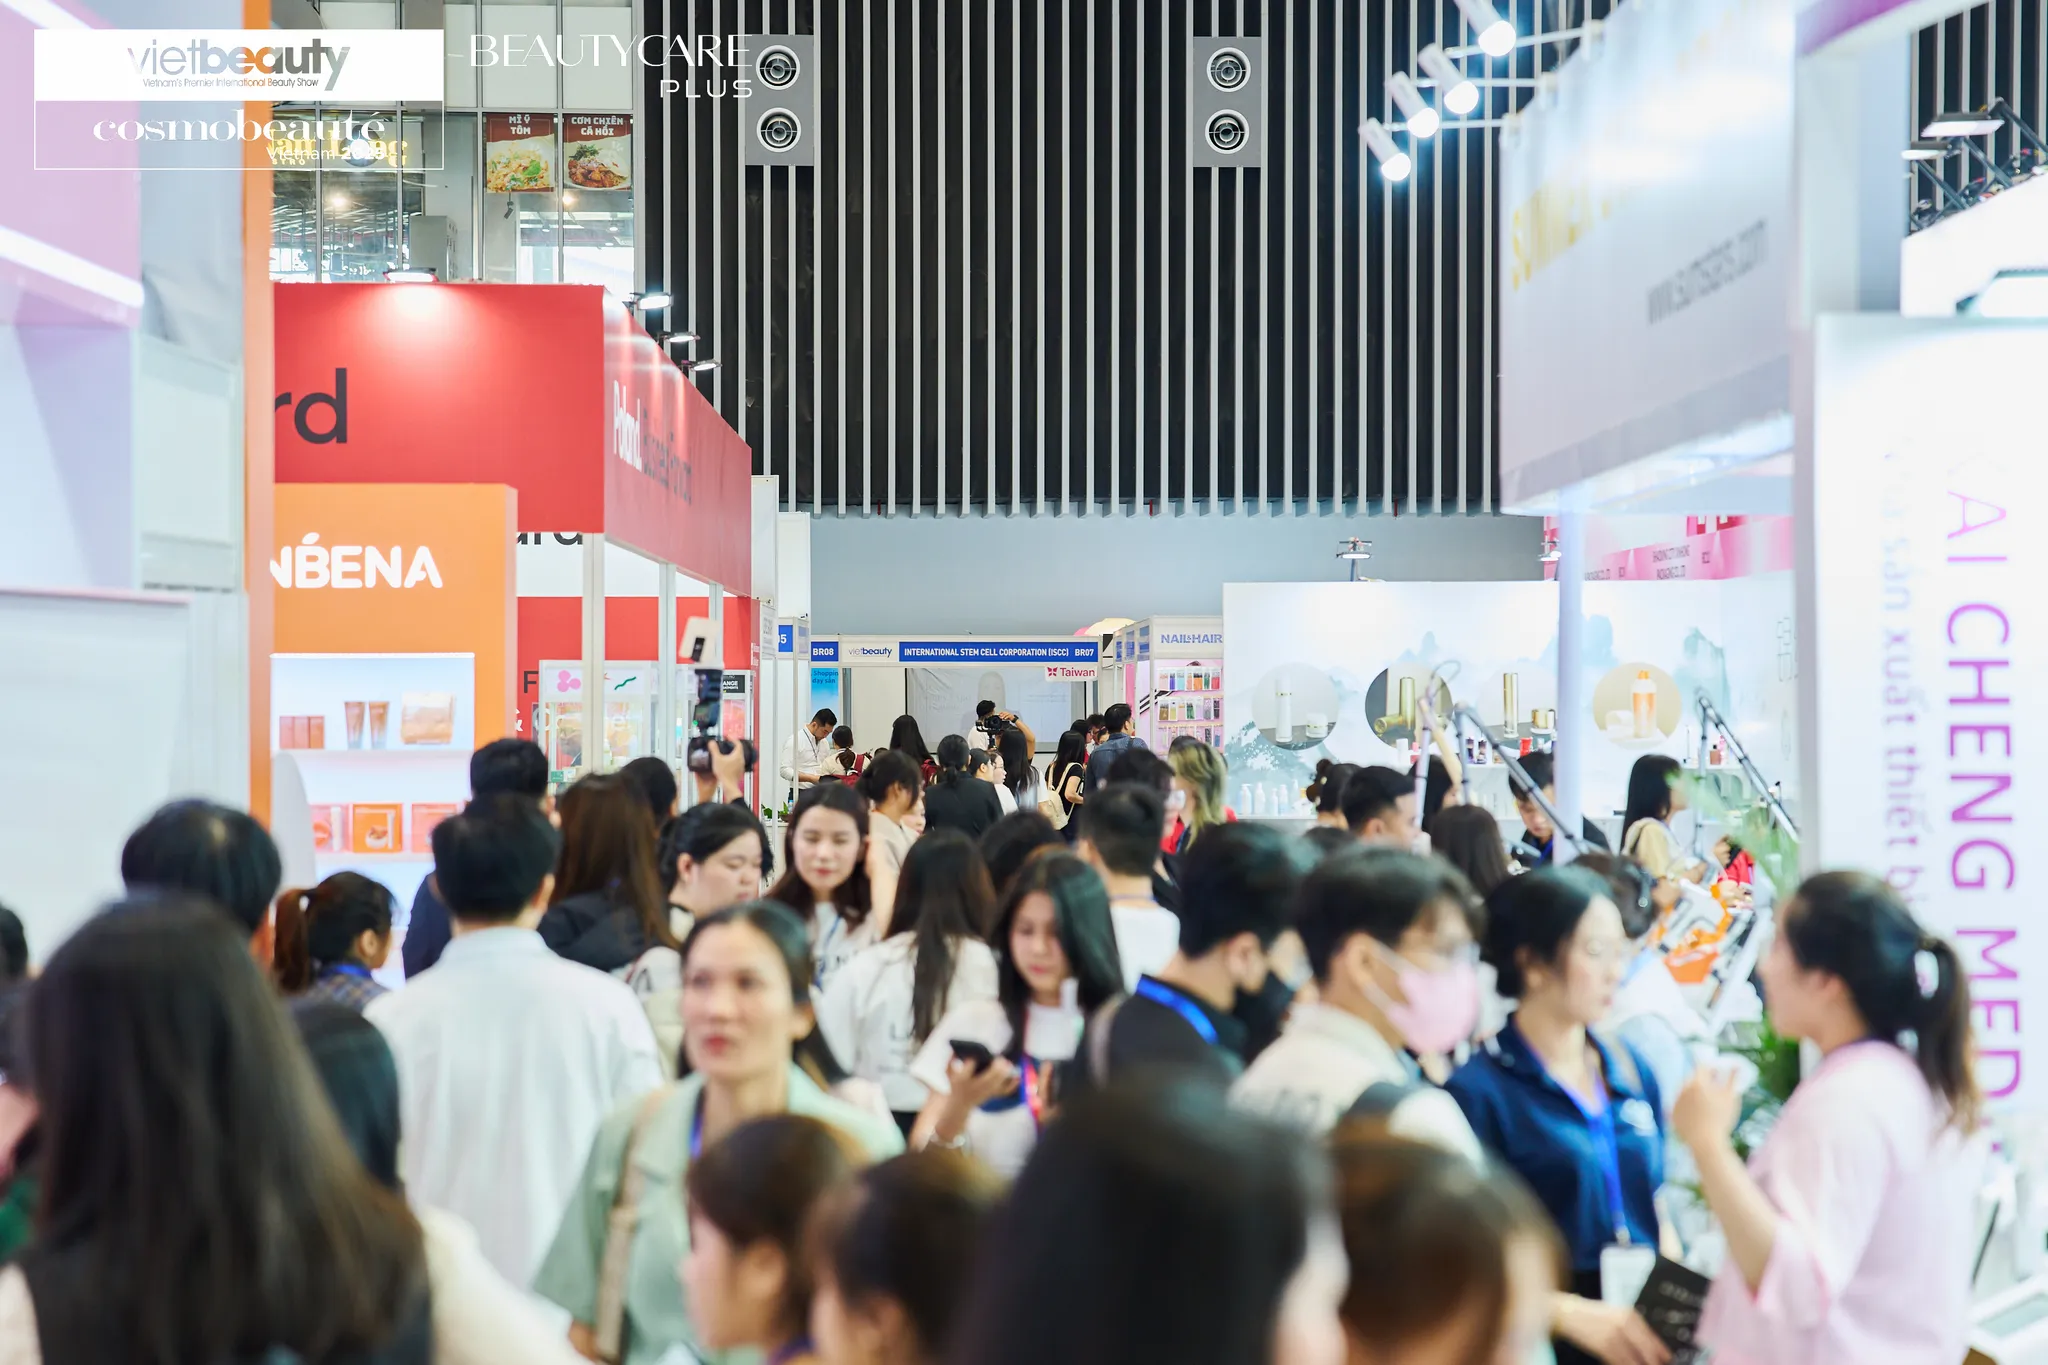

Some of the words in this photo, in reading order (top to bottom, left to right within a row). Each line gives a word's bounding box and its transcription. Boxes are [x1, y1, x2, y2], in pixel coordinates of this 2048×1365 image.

[812, 648, 835, 656] BR08
[848, 647, 892, 658] vietbeauty
[904, 648, 959, 656] INTERNATIONAL
[960, 648, 979, 656] STEM
[980, 648, 998, 656] CELL
[999, 648, 1047, 656] CORPORATION
[1048, 648, 1069, 657] (ISCC)
[1074, 648, 1094, 656] BR07
[1059, 667, 1096, 677] Taiwan
[1946, 602, 2015, 890] CHENG
